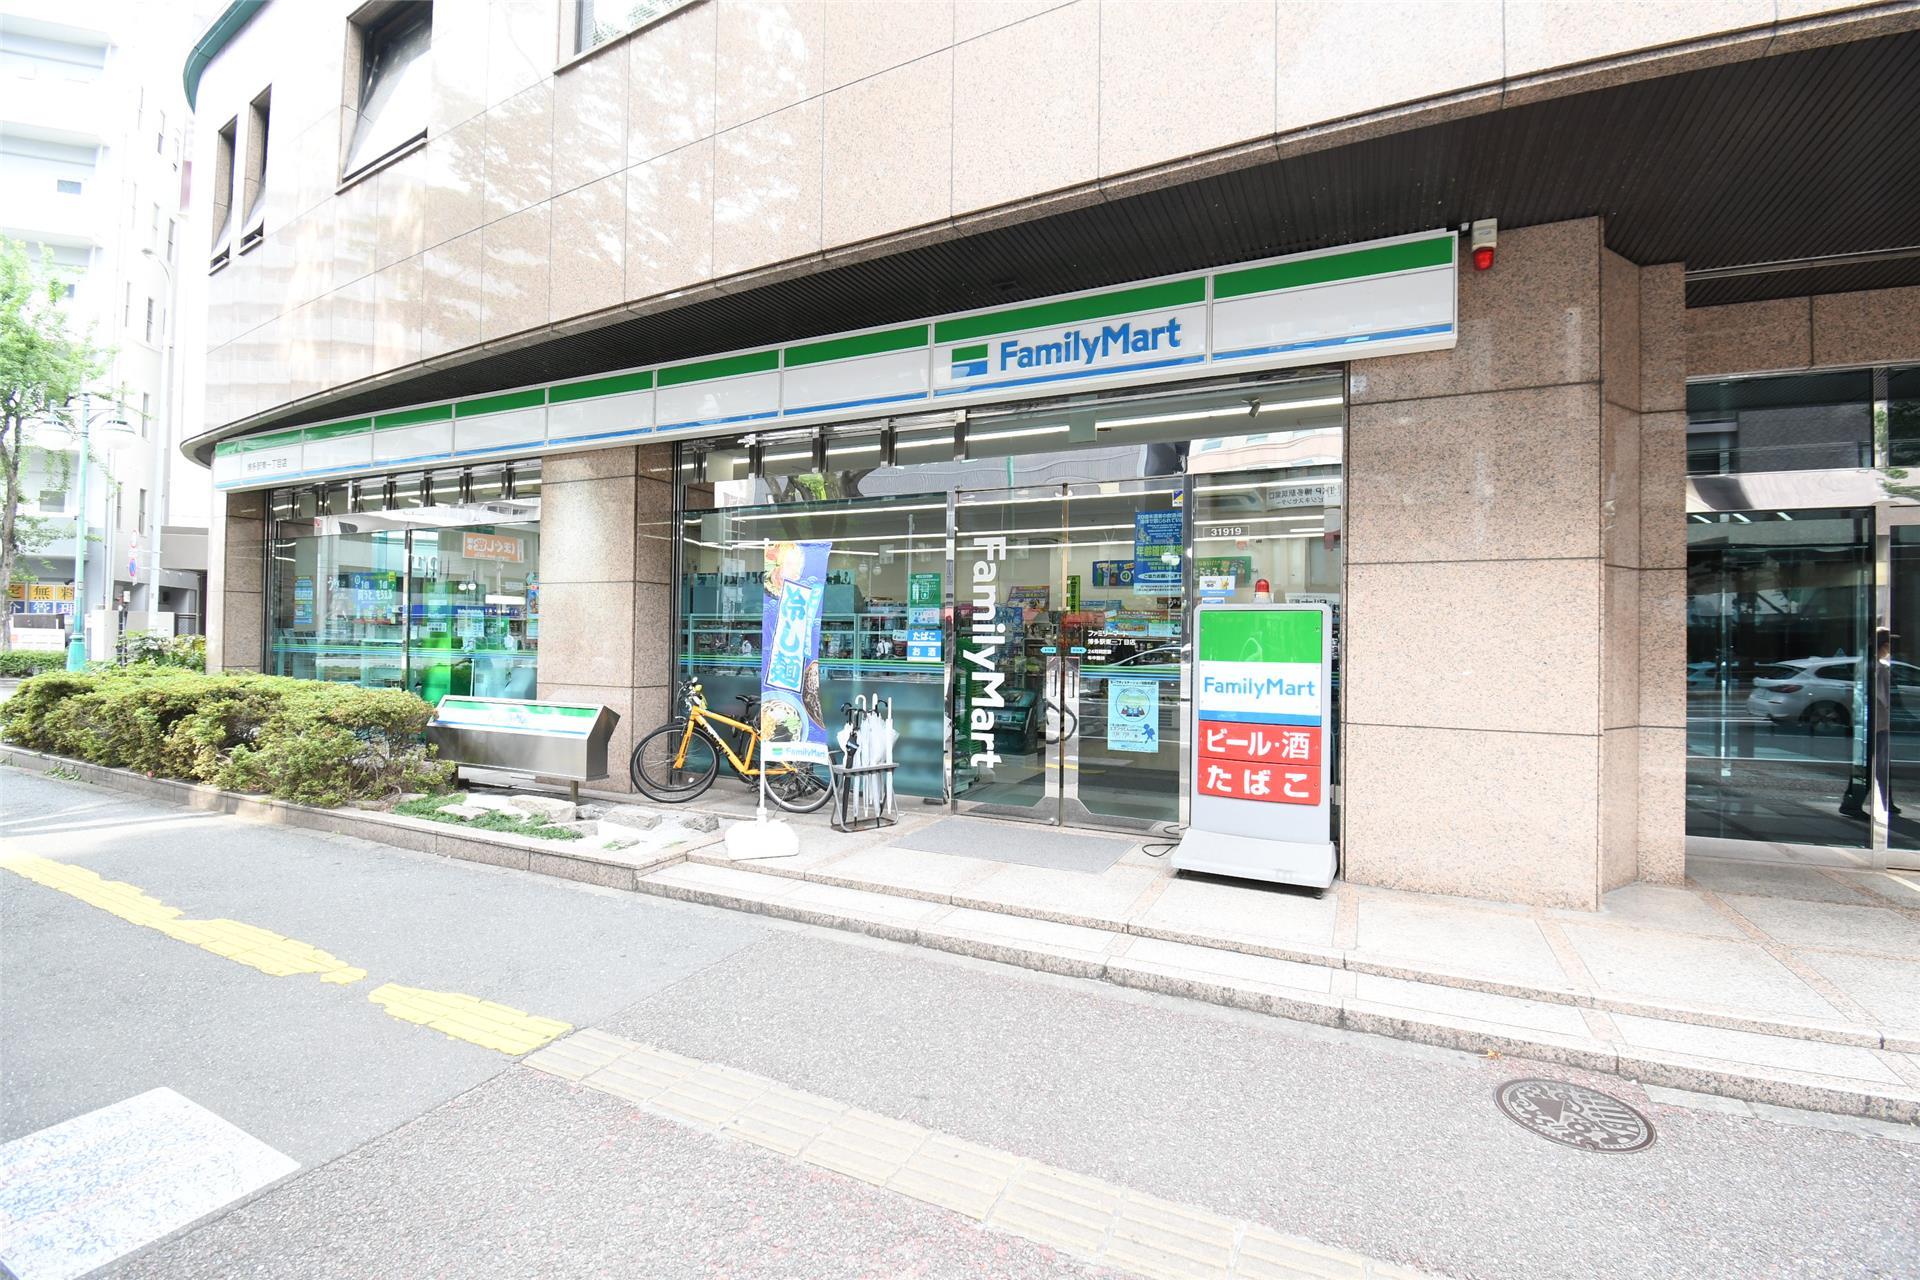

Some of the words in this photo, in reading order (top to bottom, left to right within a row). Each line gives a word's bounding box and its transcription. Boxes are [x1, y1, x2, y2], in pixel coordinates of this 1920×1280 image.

[1000, 317, 1182, 371] FamilyMart
[1210, 527, 1242, 536] 31919
[912, 631, 936, 641] たばこ
[962, 536, 1007, 769] FamilyMart
[1203, 676, 1316, 700] FamilyMart
[785, 746, 826, 758] FamilyMart
[1206, 728, 1311, 760] ビール・酒
[1206, 764, 1310, 798] たばこ
